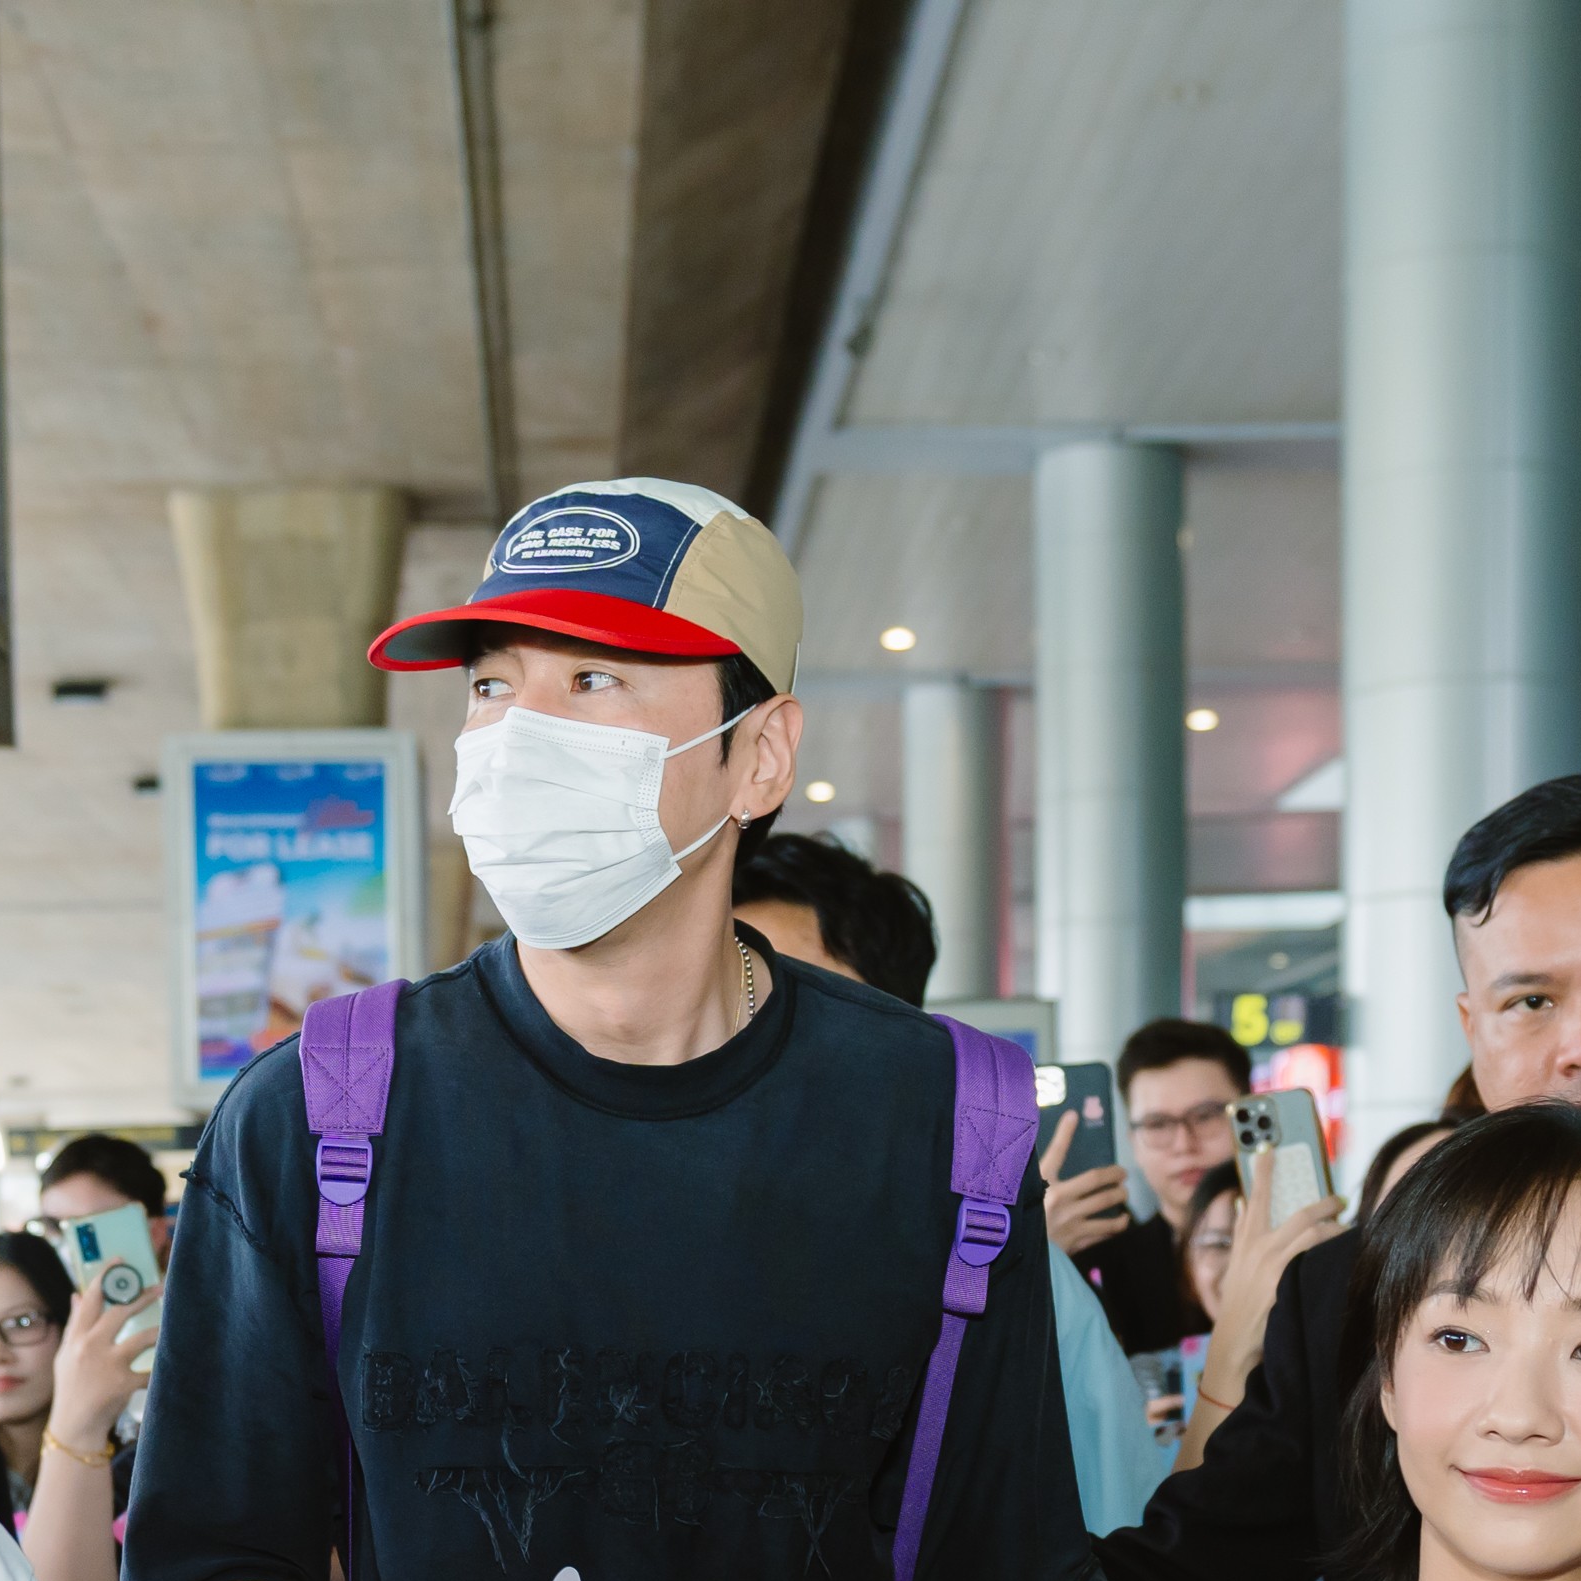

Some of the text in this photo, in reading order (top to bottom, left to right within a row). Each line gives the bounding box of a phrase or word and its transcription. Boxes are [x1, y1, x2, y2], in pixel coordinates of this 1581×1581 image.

[547, 526, 584, 538] CASE
[587, 527, 618, 539] FOR
[547, 537, 621, 551] RECKLESS
[1230, 992, 1269, 1047] 5
